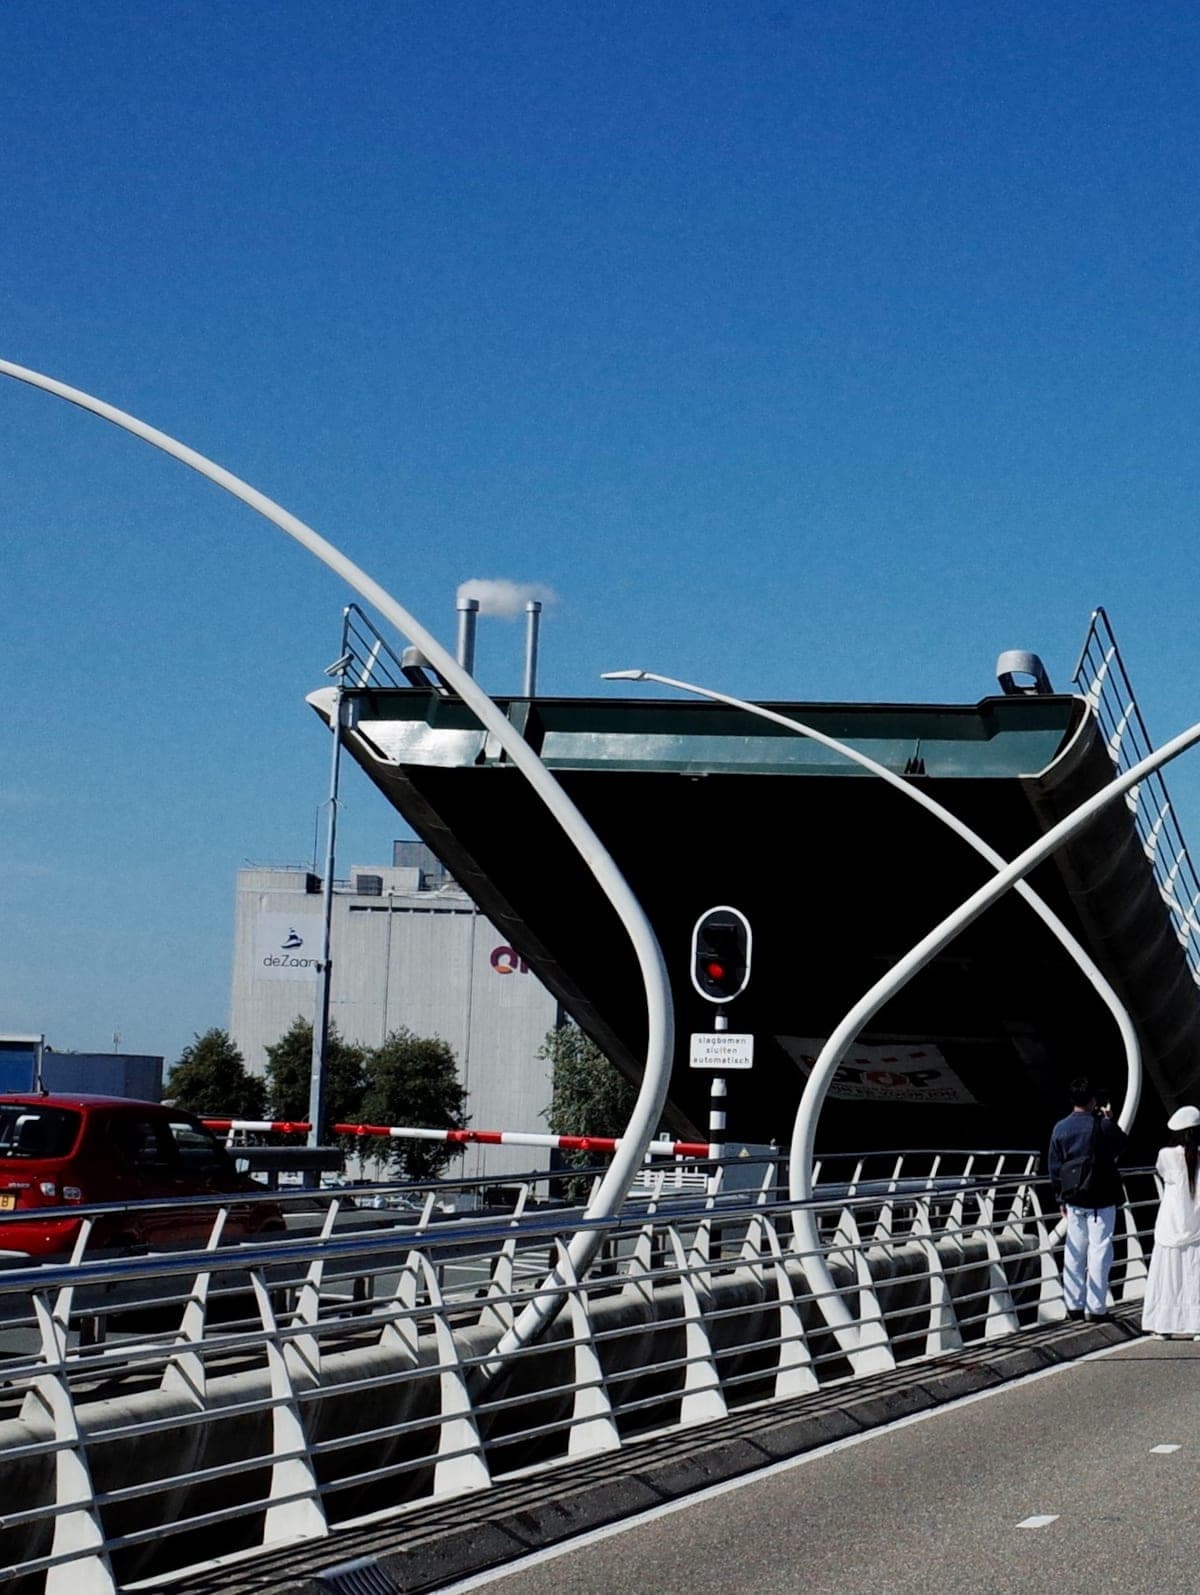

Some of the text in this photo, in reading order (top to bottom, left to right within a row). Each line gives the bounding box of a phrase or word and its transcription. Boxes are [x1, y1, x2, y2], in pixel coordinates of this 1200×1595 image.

[698, 1037, 746, 1045] slagbomen
[706, 1046, 738, 1054] sluiten
[693, 1056, 750, 1064] automatisch
